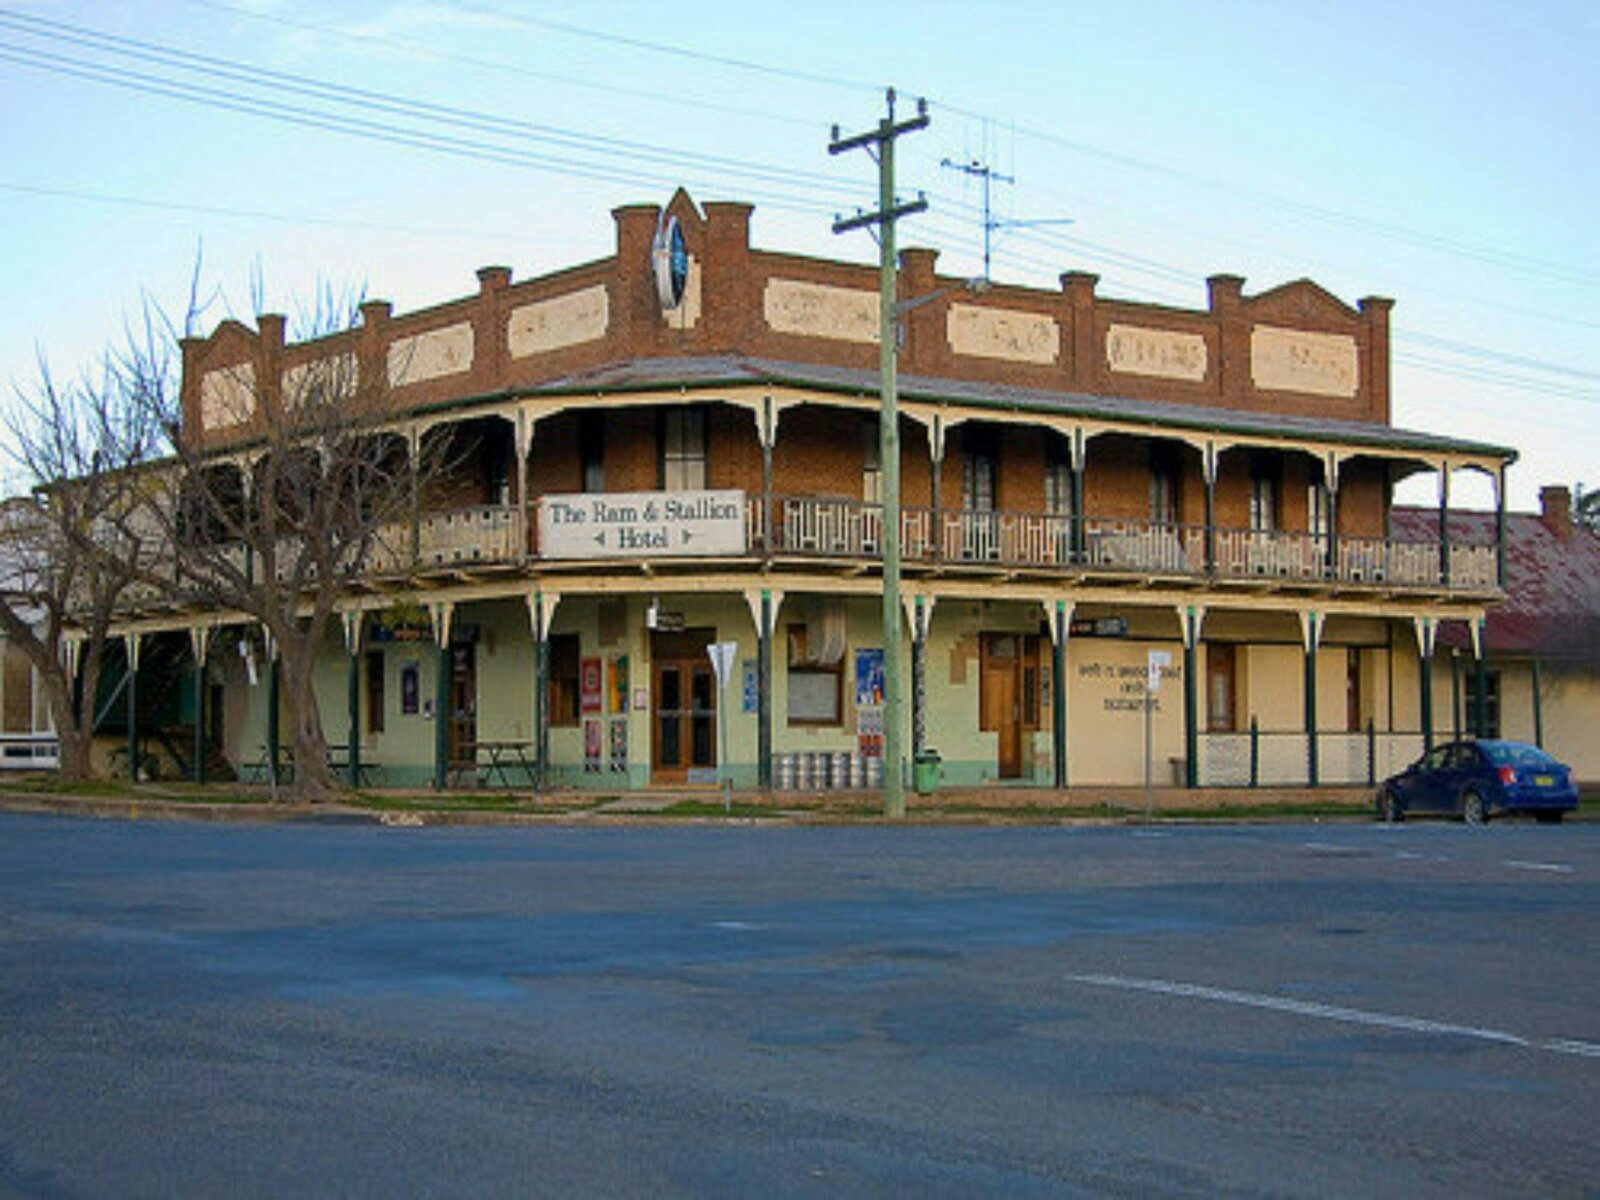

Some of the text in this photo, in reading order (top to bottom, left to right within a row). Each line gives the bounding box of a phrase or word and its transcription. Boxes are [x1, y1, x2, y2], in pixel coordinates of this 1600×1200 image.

[549, 497, 738, 524] The Ram & Stallion
[618, 527, 669, 549] Hotel
